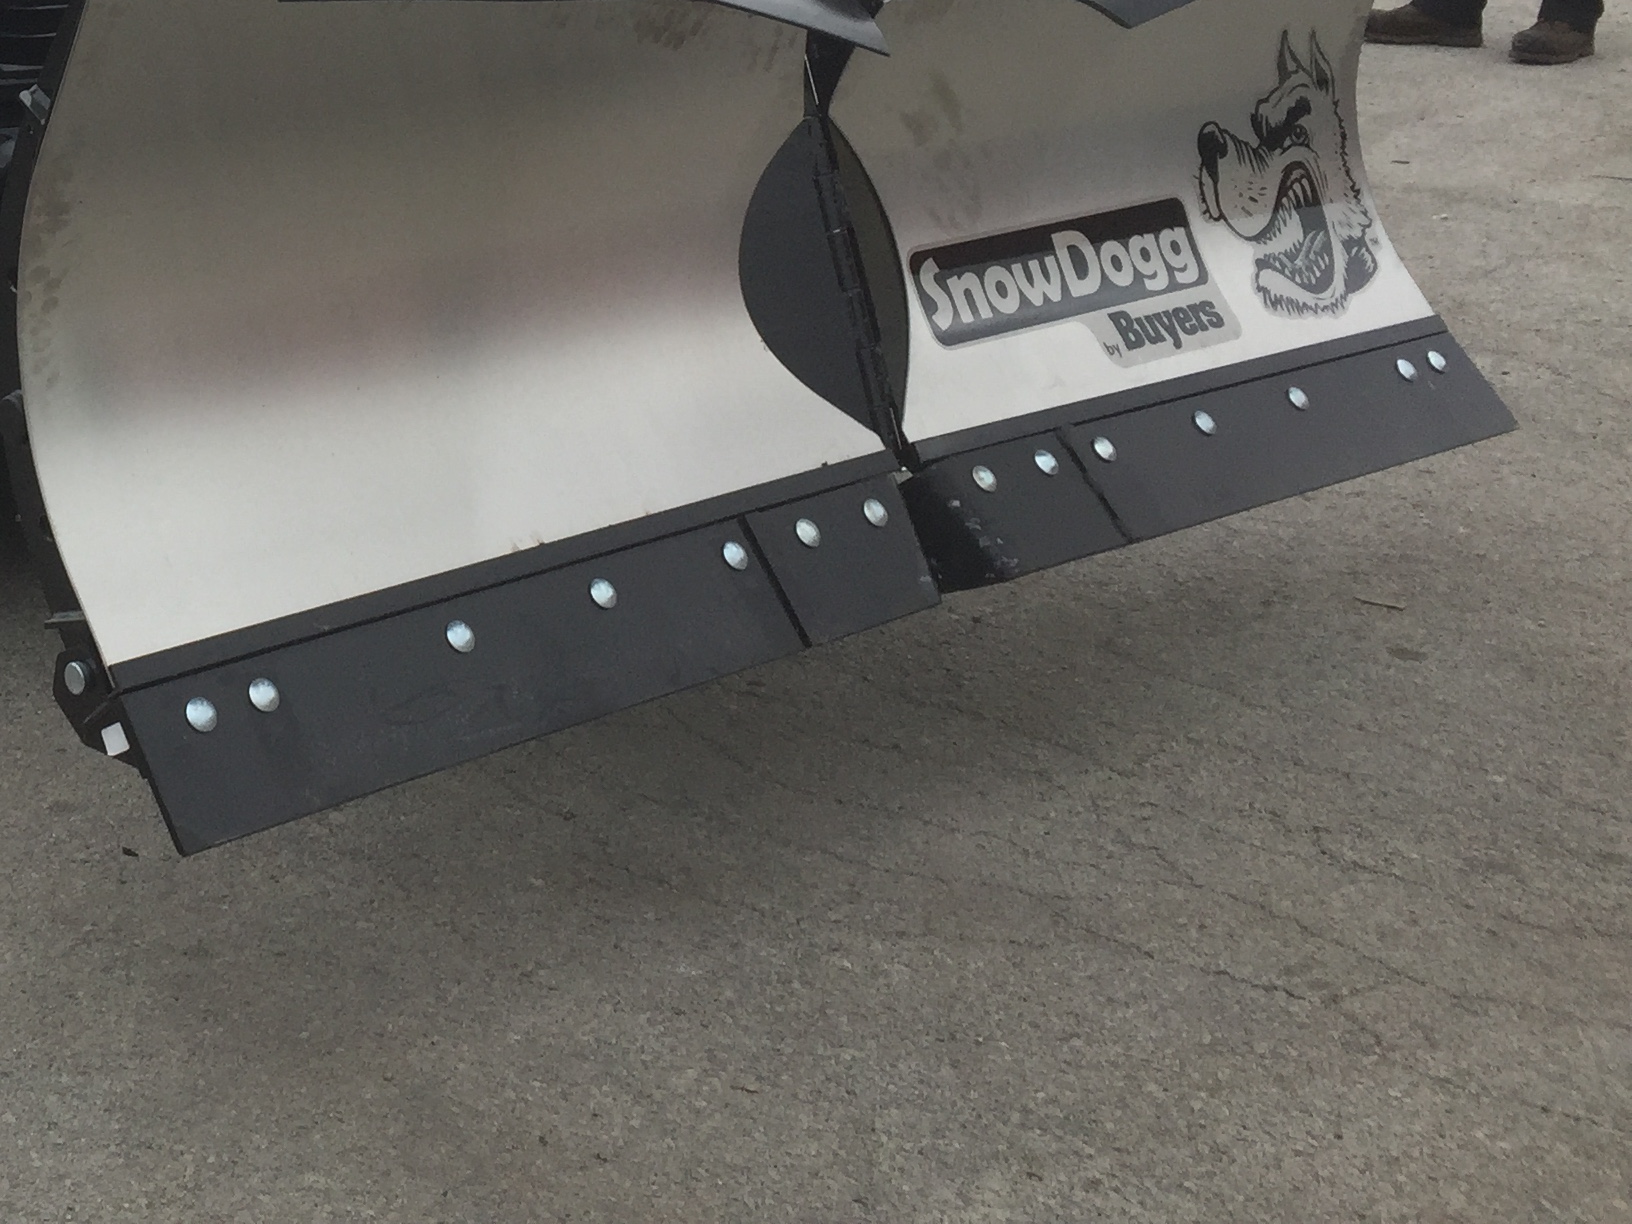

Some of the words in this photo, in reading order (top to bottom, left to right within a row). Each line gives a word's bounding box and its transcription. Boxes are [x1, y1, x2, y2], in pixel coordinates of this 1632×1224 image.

[916, 226, 1200, 332] SnowDogg
[1104, 338, 1123, 358] by
[1107, 298, 1225, 352] Buyers
